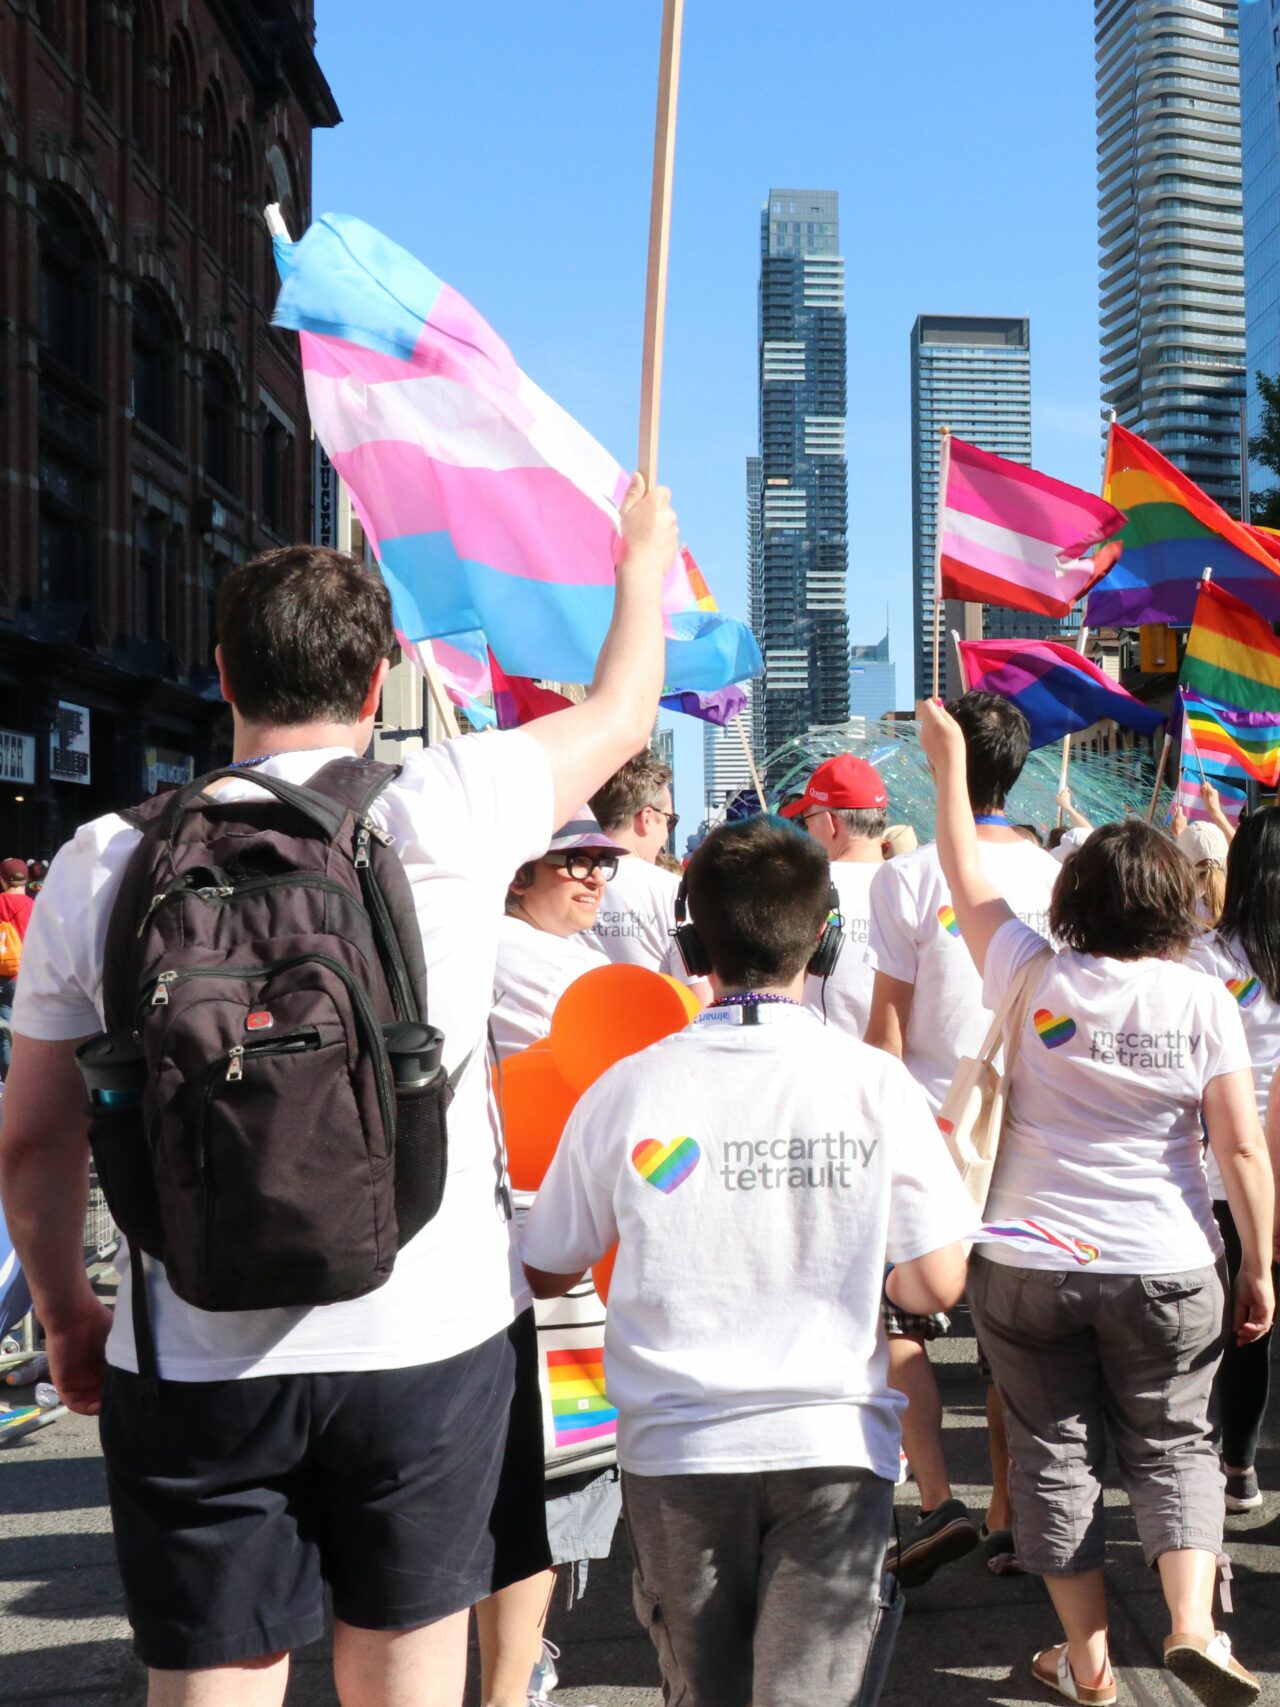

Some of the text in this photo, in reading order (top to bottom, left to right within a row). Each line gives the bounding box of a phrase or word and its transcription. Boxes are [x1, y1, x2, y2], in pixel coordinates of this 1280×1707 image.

[1093, 1029, 1201, 1055] mccarthy
[1089, 1044, 1185, 1069] tetrault
[723, 1131, 878, 1168] mccarthy
[719, 1161, 852, 1191] tetrault
